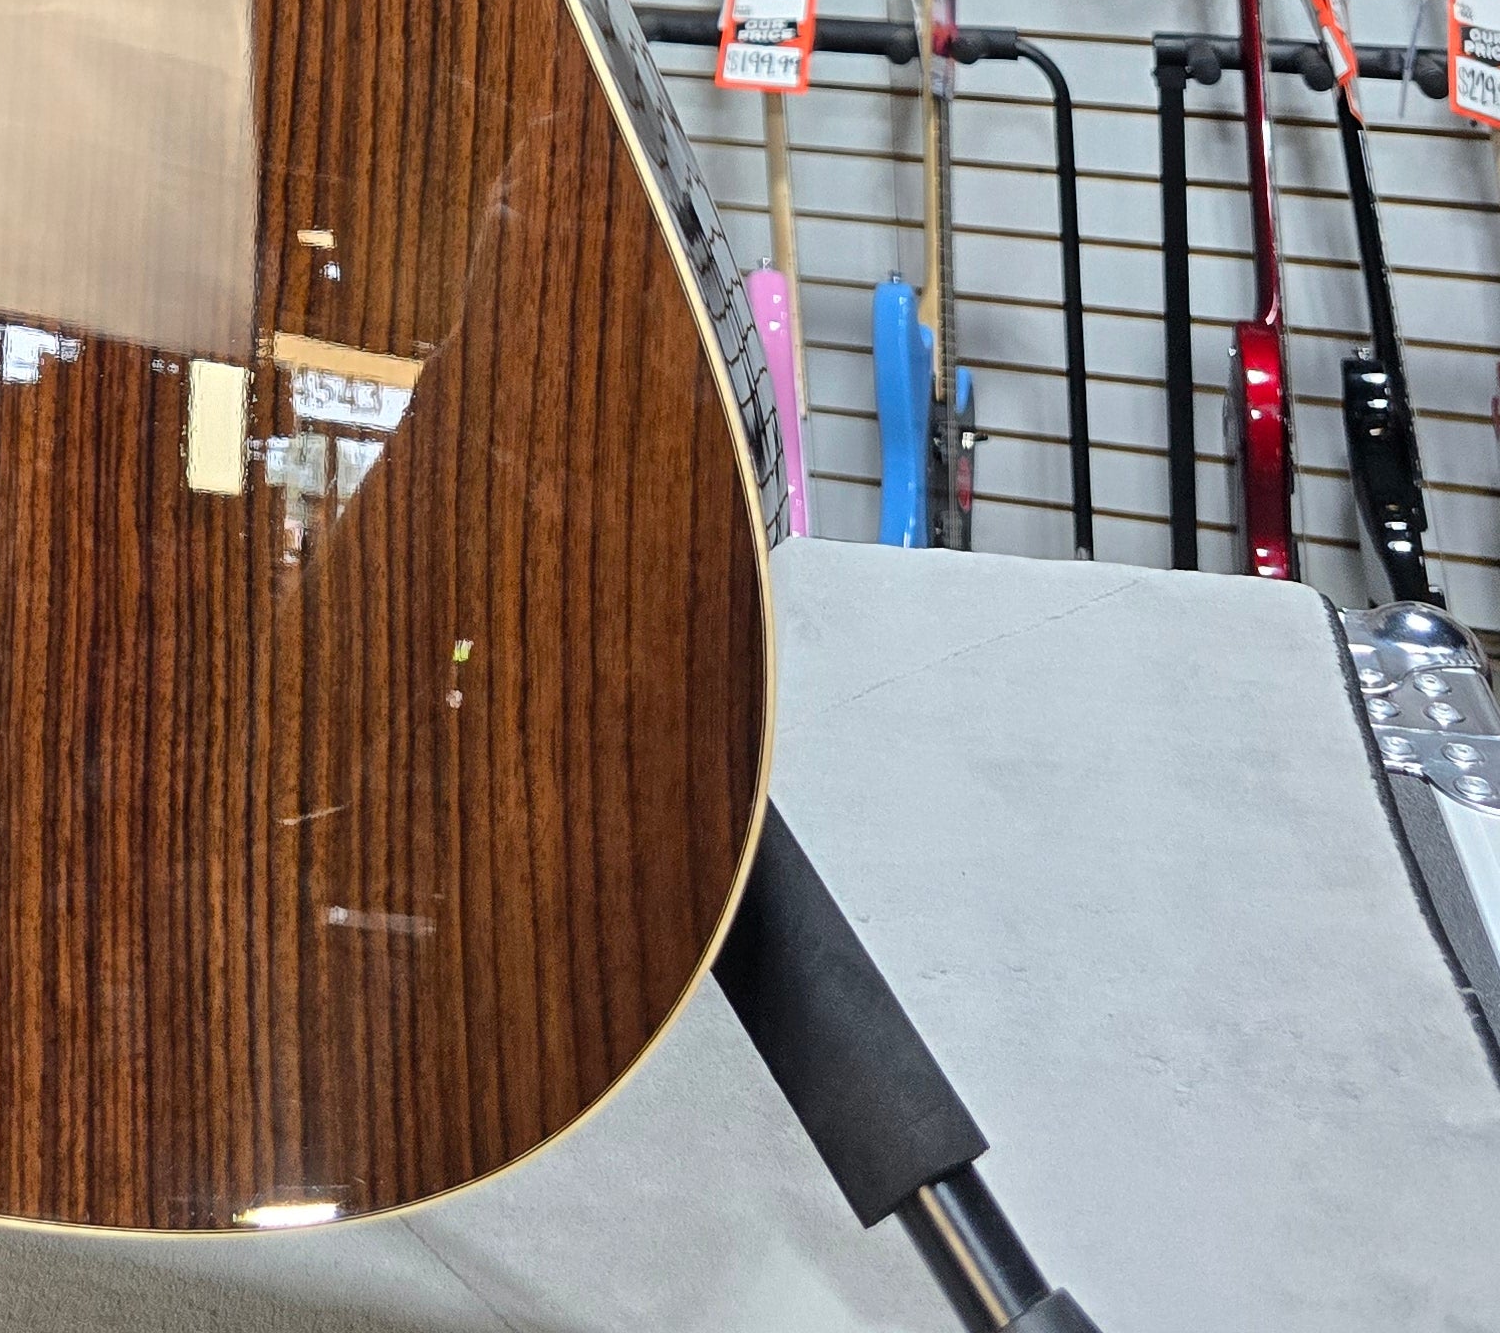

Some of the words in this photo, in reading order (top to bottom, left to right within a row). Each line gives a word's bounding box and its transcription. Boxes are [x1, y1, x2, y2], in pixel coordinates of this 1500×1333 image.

[744, 18, 789, 30] OUR
[737, 27, 797, 44] PRICE
[1463, 39, 1500, 66] PRIC
